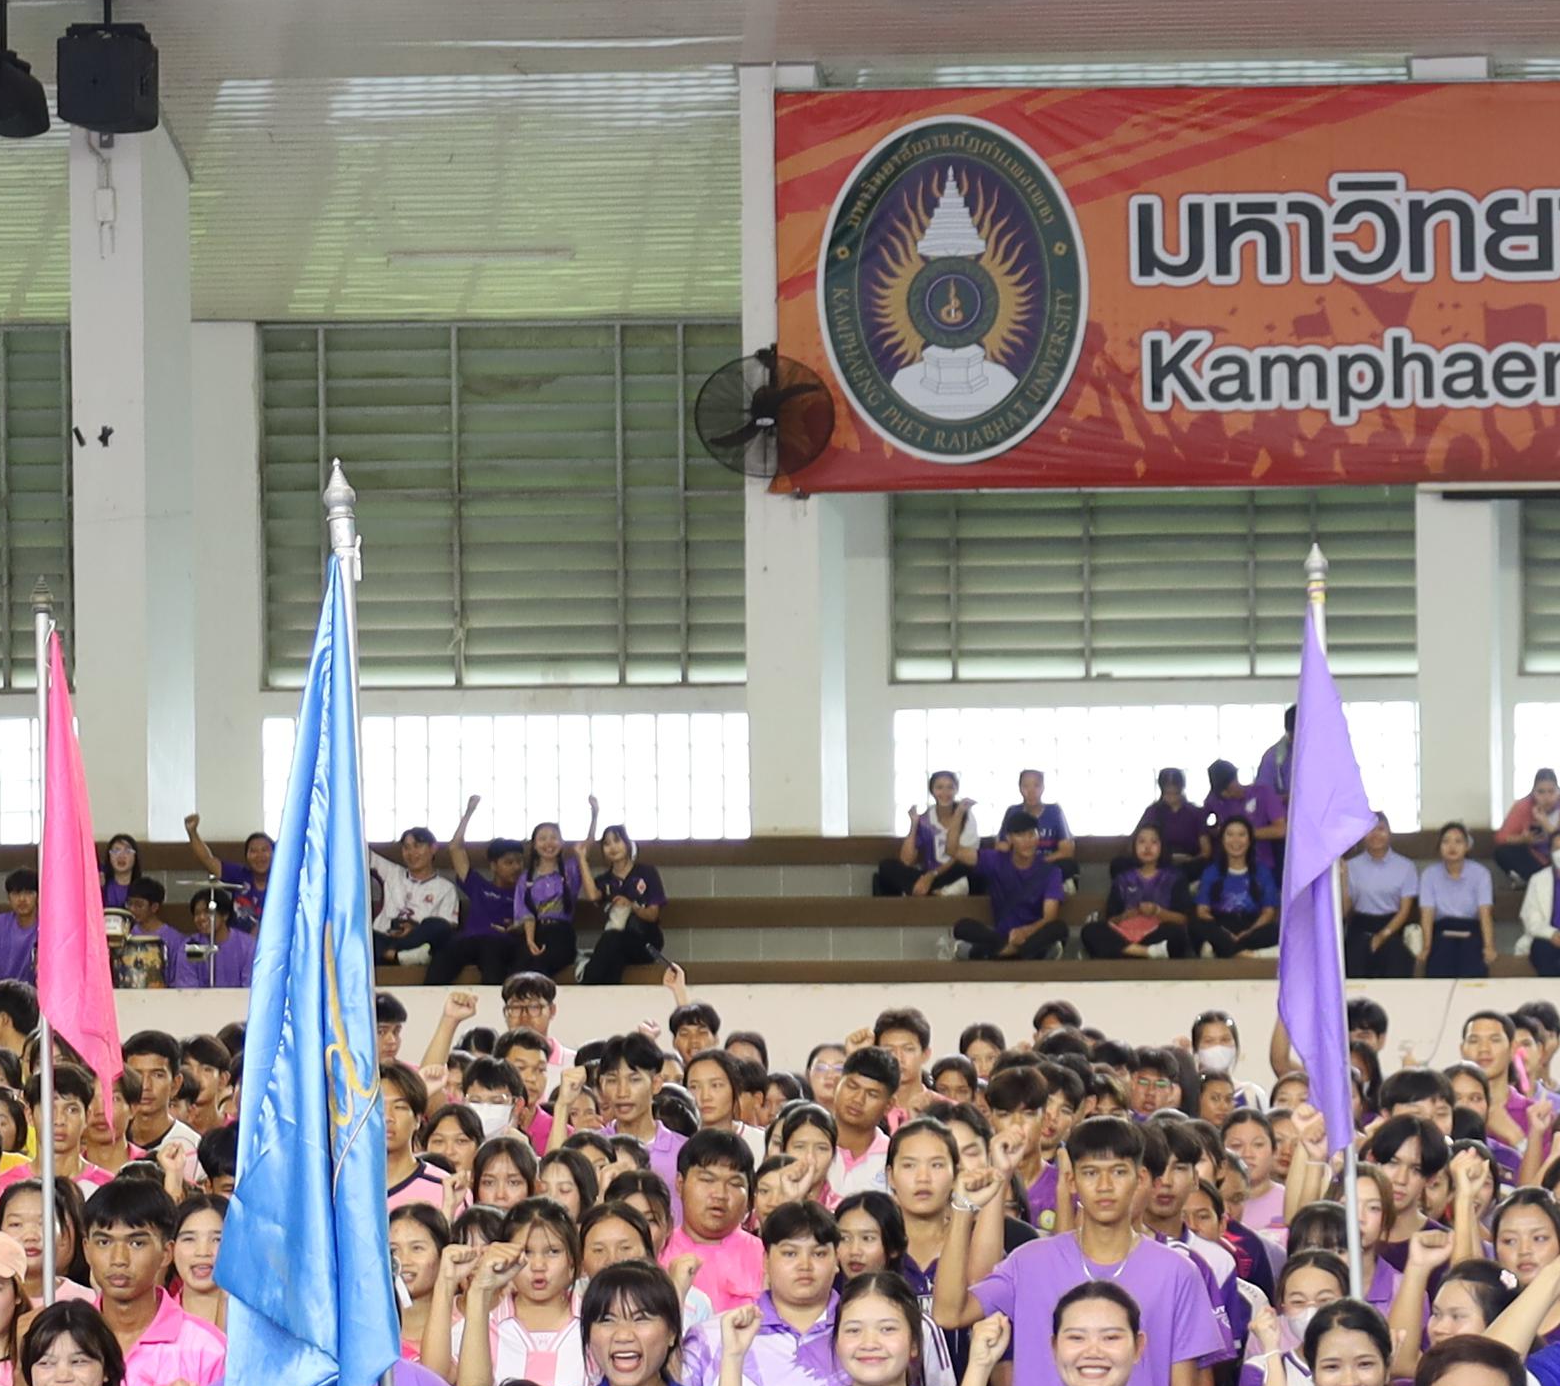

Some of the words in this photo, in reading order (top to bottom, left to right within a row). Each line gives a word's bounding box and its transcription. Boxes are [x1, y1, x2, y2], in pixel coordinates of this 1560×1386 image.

[832, 287, 886, 407] KAMPHAENG
[881, 407, 929, 443] PHET
[934, 400, 1030, 451] RAJABHAT
[1029, 287, 1074, 403] UNIVERSITY
